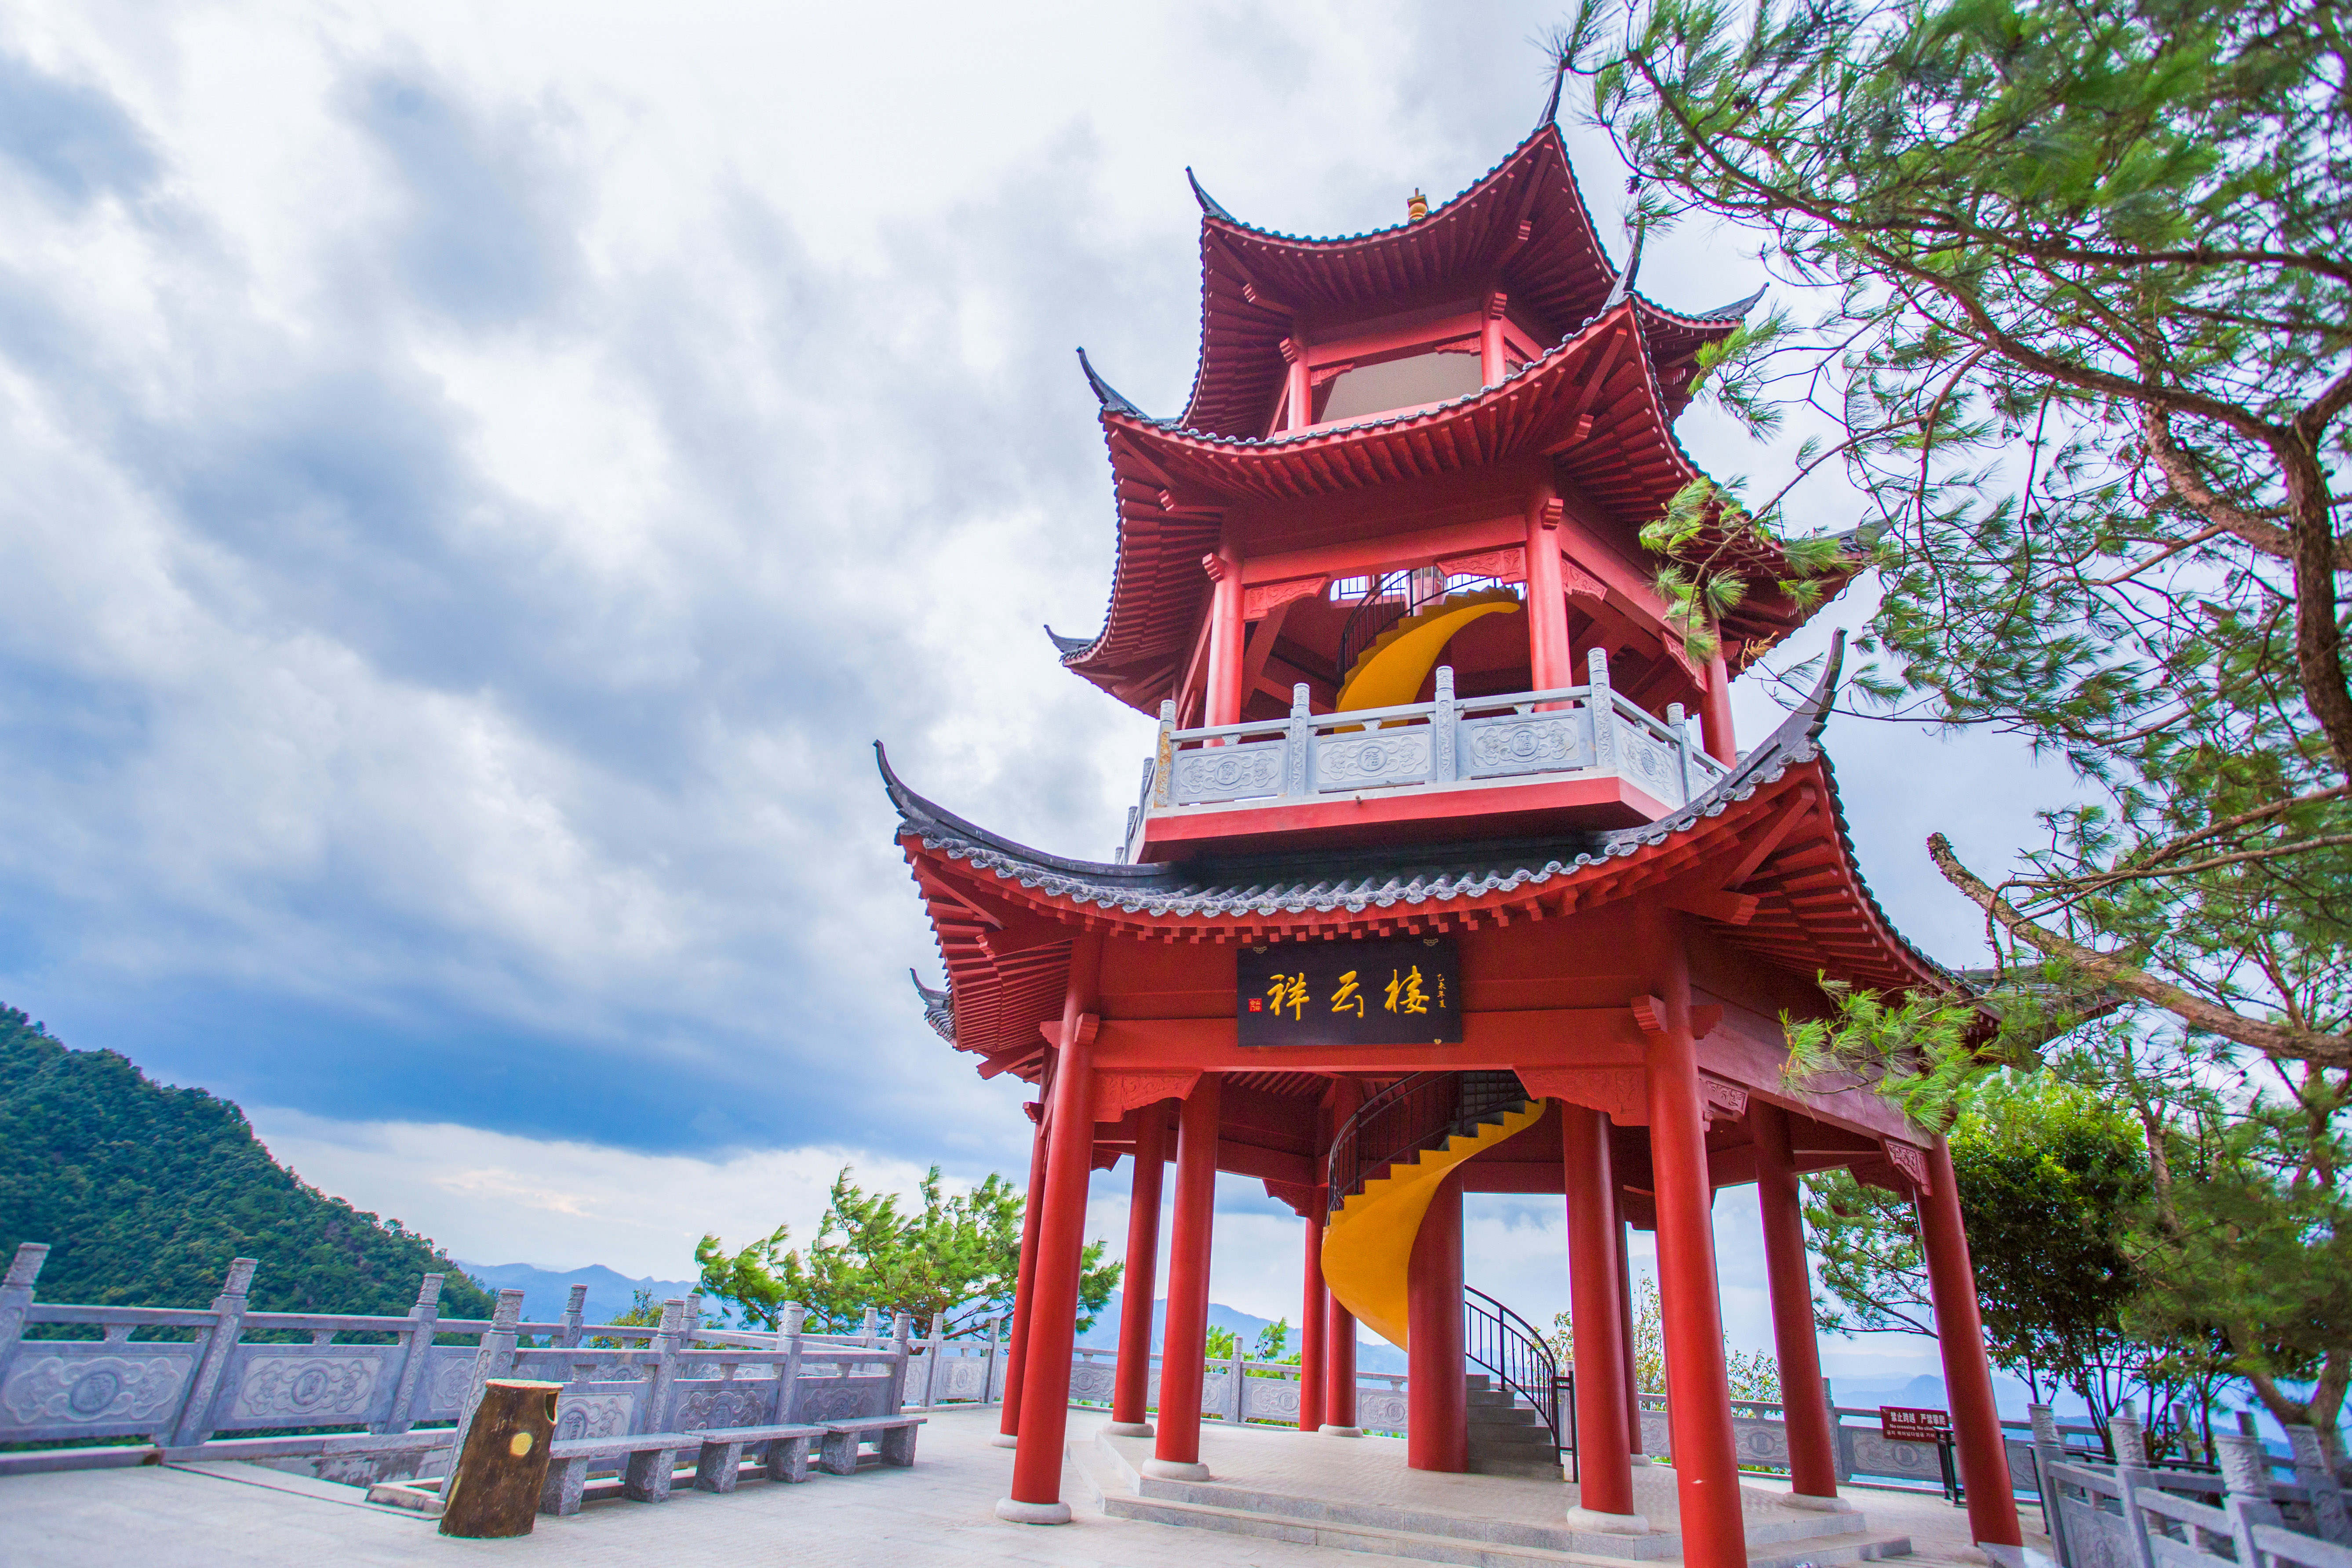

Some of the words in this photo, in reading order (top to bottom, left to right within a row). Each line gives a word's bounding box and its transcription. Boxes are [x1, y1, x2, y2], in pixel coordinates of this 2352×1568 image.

[1267, 965, 1429, 1021] 祥云楼
[1890, 1412, 1916, 1423] 禁止跨越
[1920, 1413, 1946, 1425] 严禁攀爬
